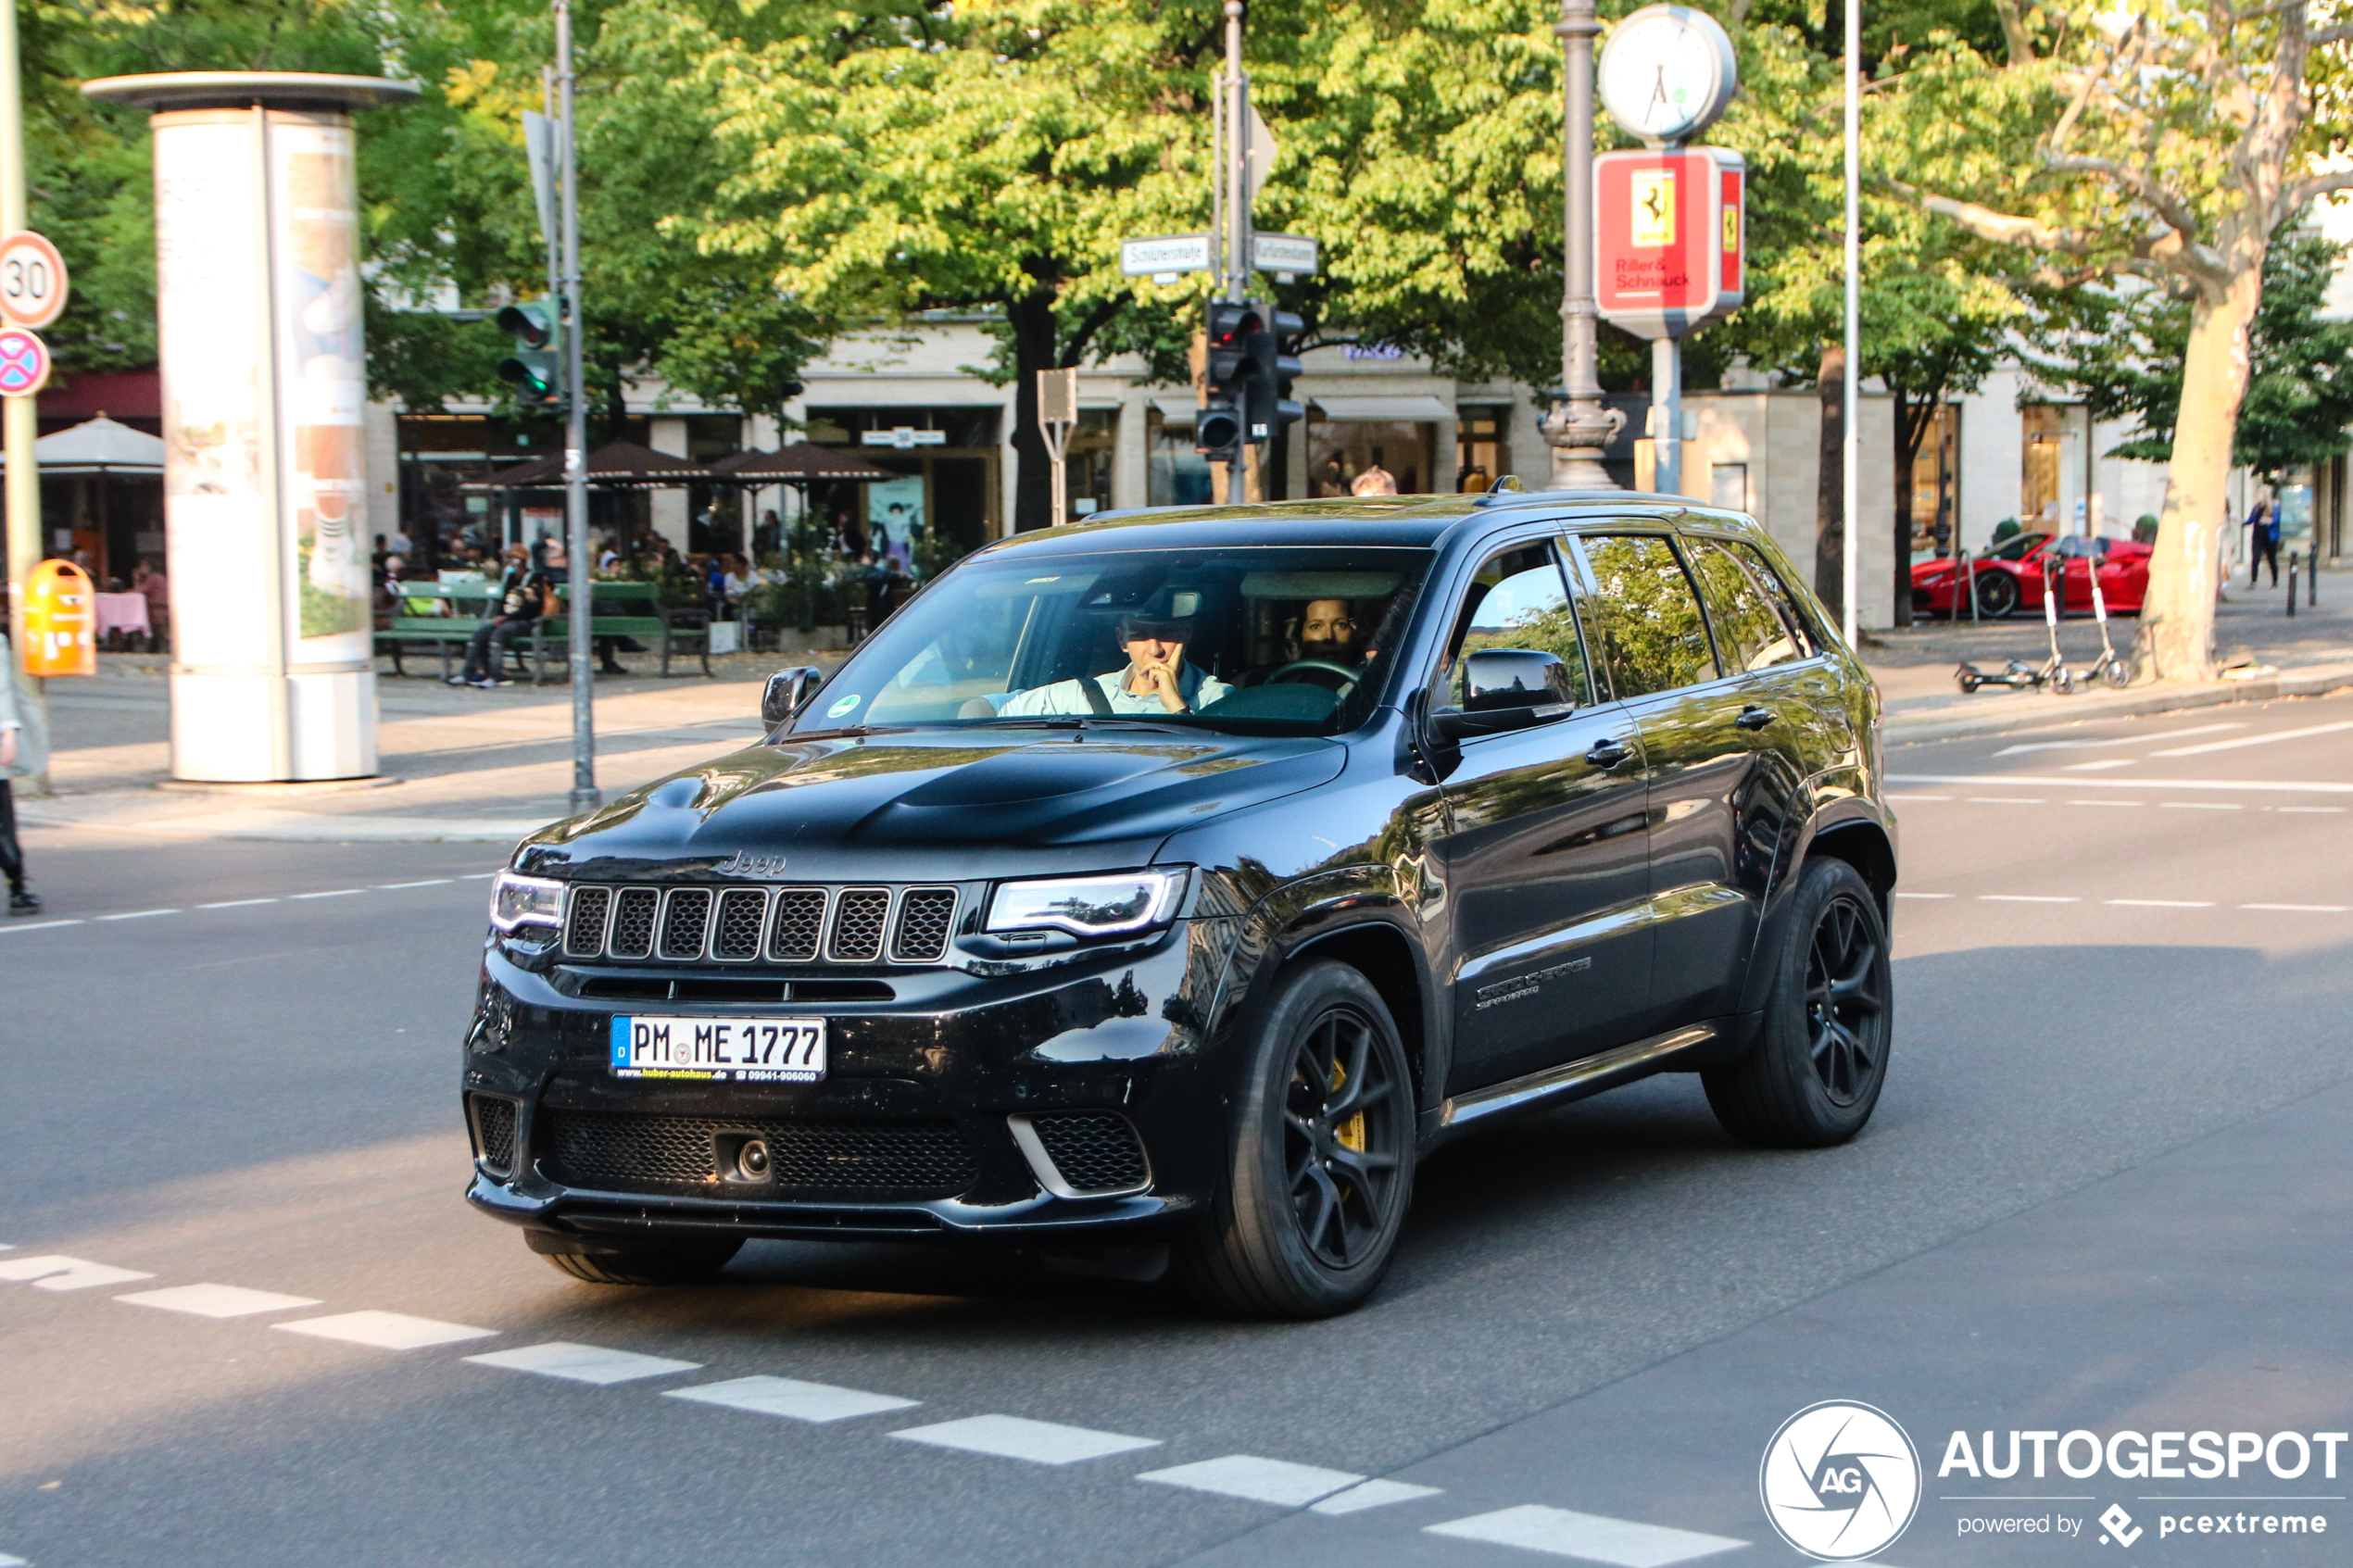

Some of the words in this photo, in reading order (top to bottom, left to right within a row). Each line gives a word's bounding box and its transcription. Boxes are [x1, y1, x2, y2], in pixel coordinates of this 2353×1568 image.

[1616, 257, 1654, 272] Riller
[5, 258, 46, 298] 30
[1616, 272, 1692, 289] Schnauck
[720, 849, 786, 878] Jeep
[617, 1046, 626, 1059] D
[635, 1022, 670, 1061] PM
[694, 1023, 732, 1063] ME
[742, 1024, 819, 1065] 1777
[616, 1068, 727, 1080] www.huber-autohaus.de
[748, 1071, 817, 1082] 09941-906060
